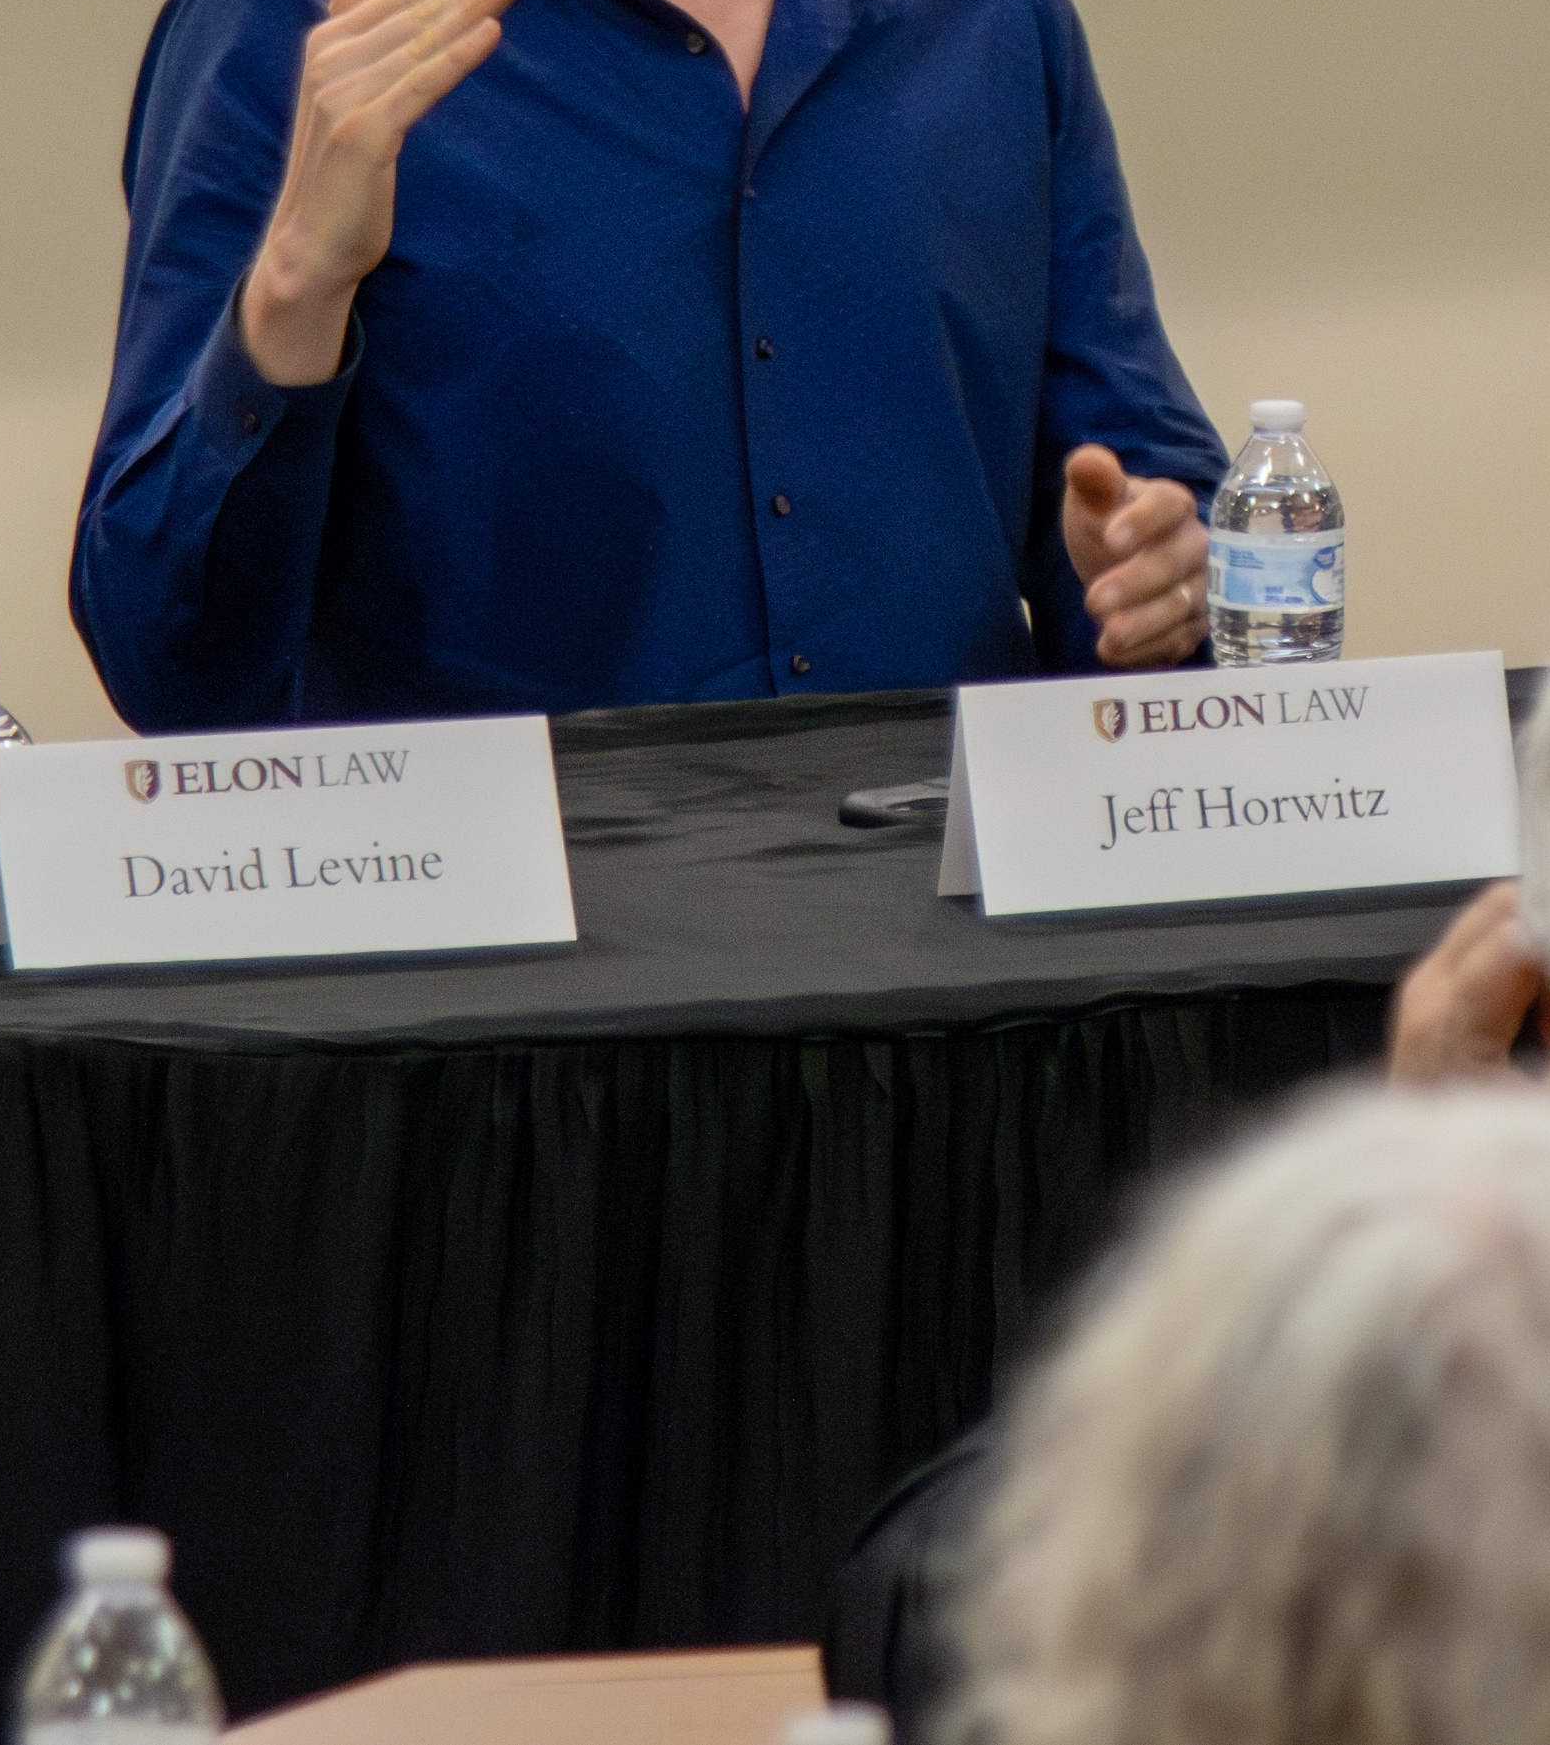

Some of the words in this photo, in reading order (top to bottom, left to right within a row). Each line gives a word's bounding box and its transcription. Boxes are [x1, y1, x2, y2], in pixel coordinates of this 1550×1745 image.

[1138, 692, 1267, 735] ELON
[1277, 686, 1370, 725] LAW
[171, 755, 304, 796] ELON
[315, 749, 410, 788] LAW
[1100, 787, 1184, 851] Jeff
[1195, 777, 1389, 830] Horwitz
[122, 847, 269, 899] David
[283, 841, 444, 889] Levine
